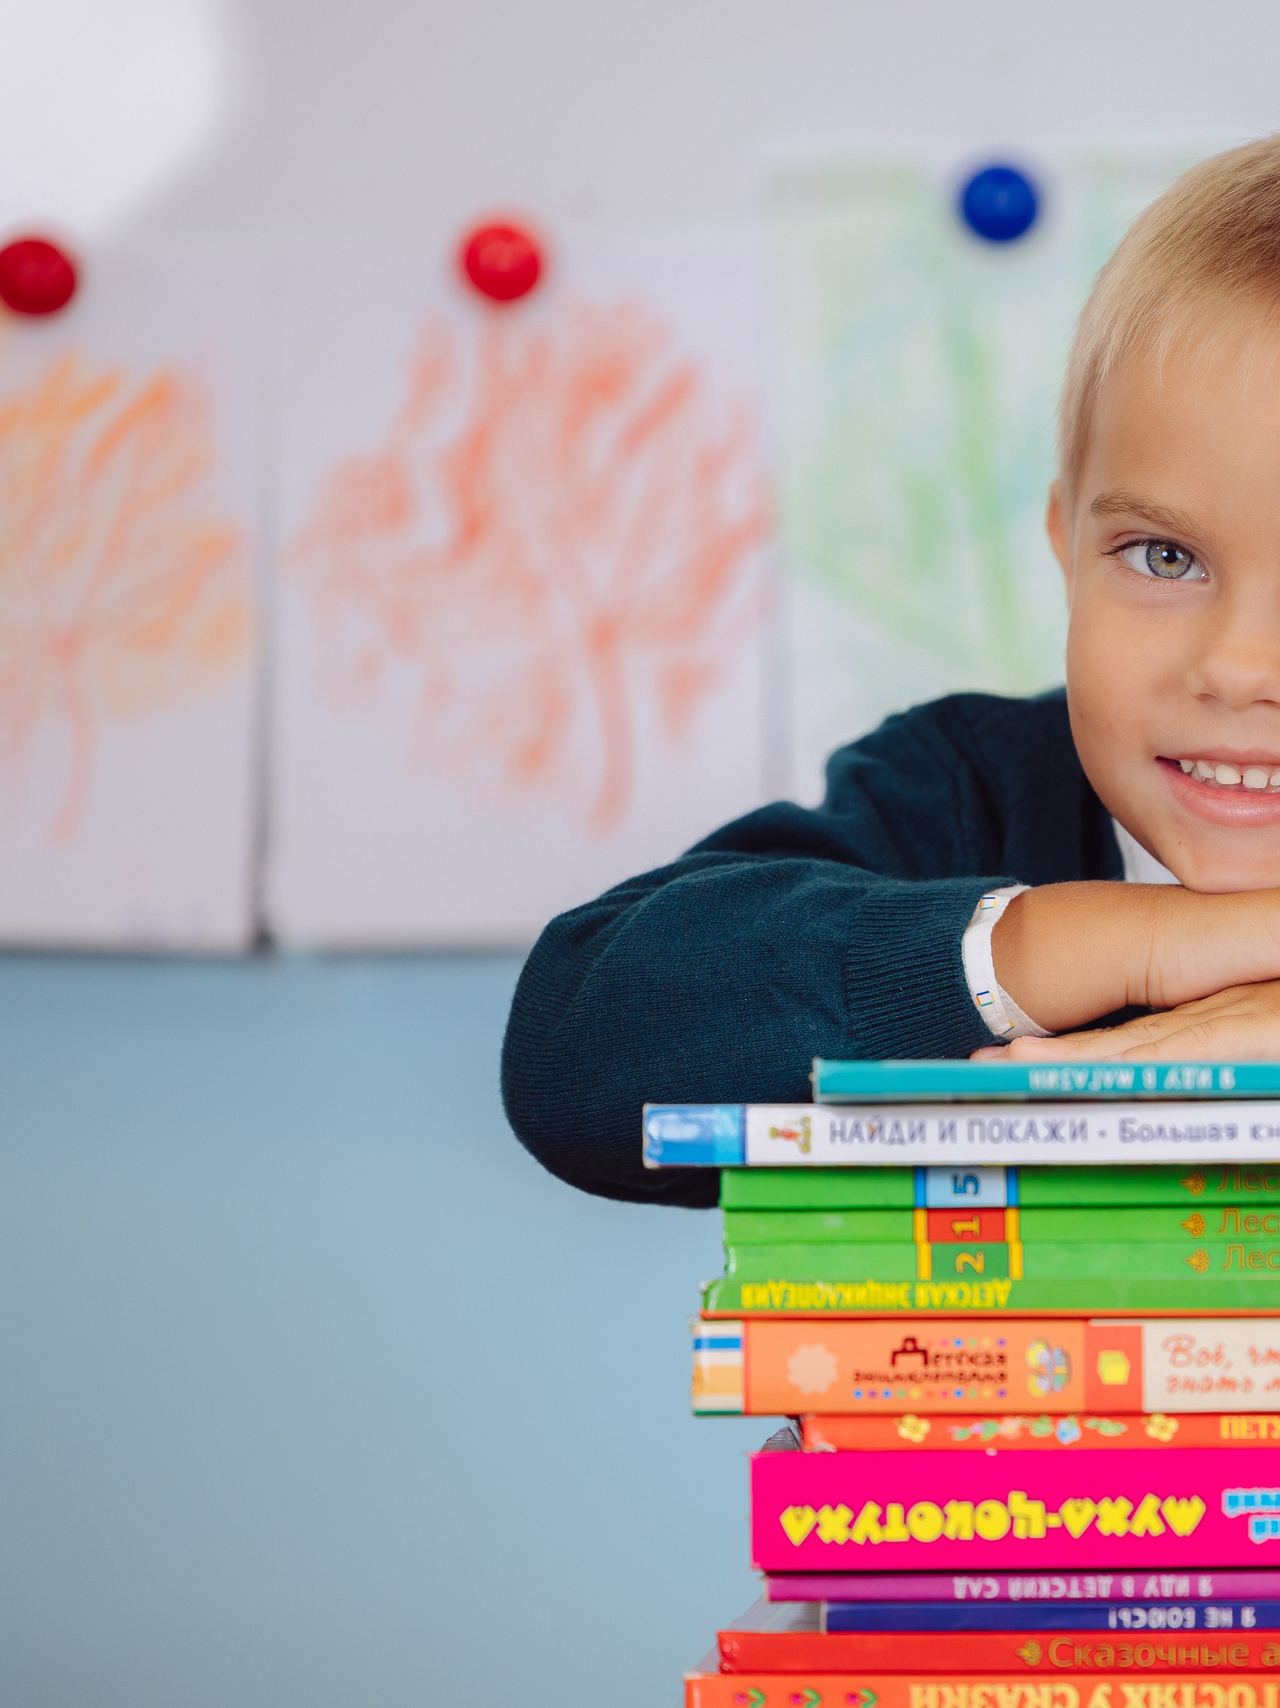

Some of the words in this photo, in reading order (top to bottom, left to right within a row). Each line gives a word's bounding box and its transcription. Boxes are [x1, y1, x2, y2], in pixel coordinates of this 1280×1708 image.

[1028, 1067, 1135, 1091] МАГАЗИН
[1142, 1067, 1157, 1090] В
[1163, 1066, 1213, 1090] ИДУ
[1219, 1067, 1236, 1090] Я
[829, 1115, 927, 1146] НАЙДИ
[937, 1118, 958, 1144] И
[966, 1117, 1089, 1144] ПОКАЖИ
[1118, 1117, 1239, 1144] Большая
[952, 1173, 980, 1196] 5
[951, 1214, 980, 1237] 1
[954, 1250, 985, 1274] 2
[740, 1279, 912, 1309] ЭНЦИКЛОПЕДИЯ
[915, 1278, 1012, 1308] ДЕТСКАЯ
[1165, 1373, 1255, 1395] знать
[779, 1490, 1206, 1546] МУХА-ЦОКОТУХА
[953, 1576, 999, 1599] САД
[1008, 1575, 1113, 1601] ДЕТСКИЙ
[1121, 1575, 1135, 1597] В
[1143, 1575, 1190, 1598] ИДУ
[1198, 1575, 1213, 1597] Я
[1108, 1606, 1196, 1629] БОЮСЬ!
[1204, 1607, 1233, 1629] НЕ
[1241, 1606, 1256, 1628] Я
[1048, 1637, 1249, 1667] Сказочные
